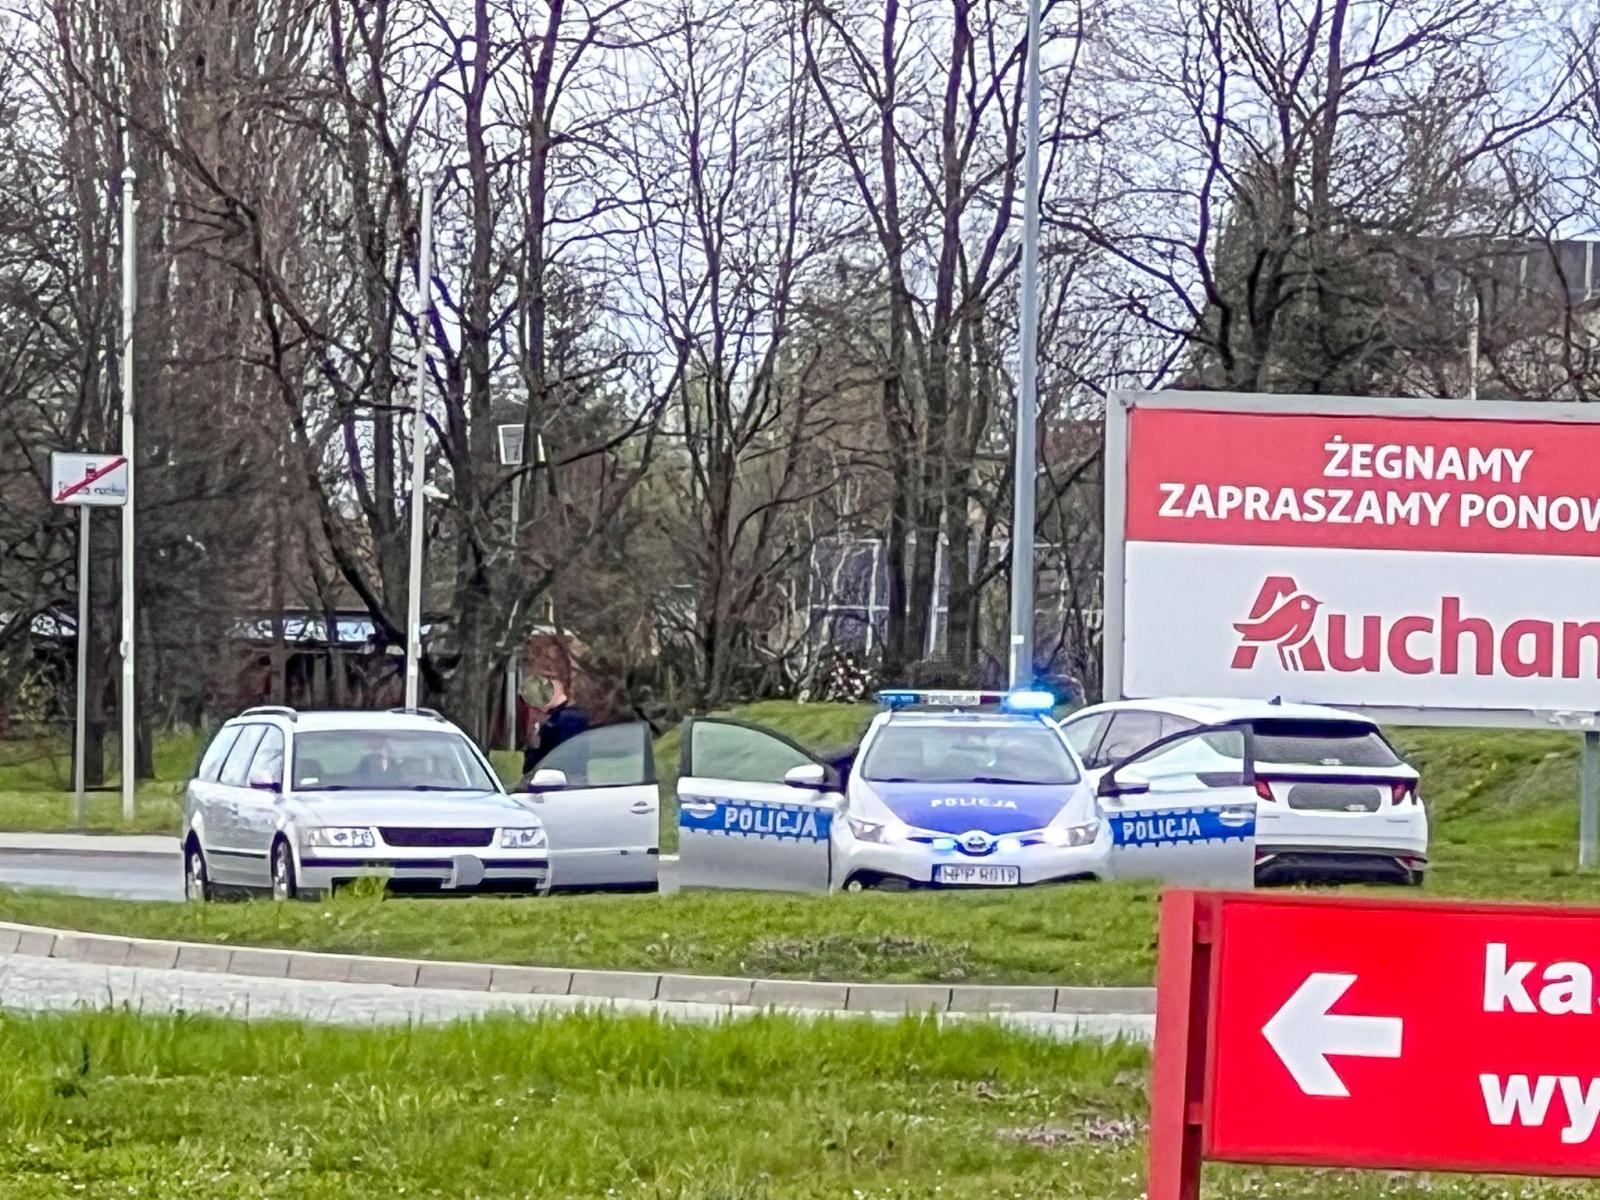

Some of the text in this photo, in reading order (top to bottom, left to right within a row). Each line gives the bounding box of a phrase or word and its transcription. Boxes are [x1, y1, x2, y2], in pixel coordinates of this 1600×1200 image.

[1323, 435, 1534, 483] ŻEGNAMY
[1158, 483, 1451, 527] ZAPRASZAMY
[1231, 576, 1600, 679] Auchan
[724, 806, 818, 837] POLICJA
[930, 797, 1018, 811] POLICJA
[1122, 817, 1201, 841] POLICJA
[1483, 942, 1600, 1015] ka
[1479, 1073, 1600, 1144] wy
